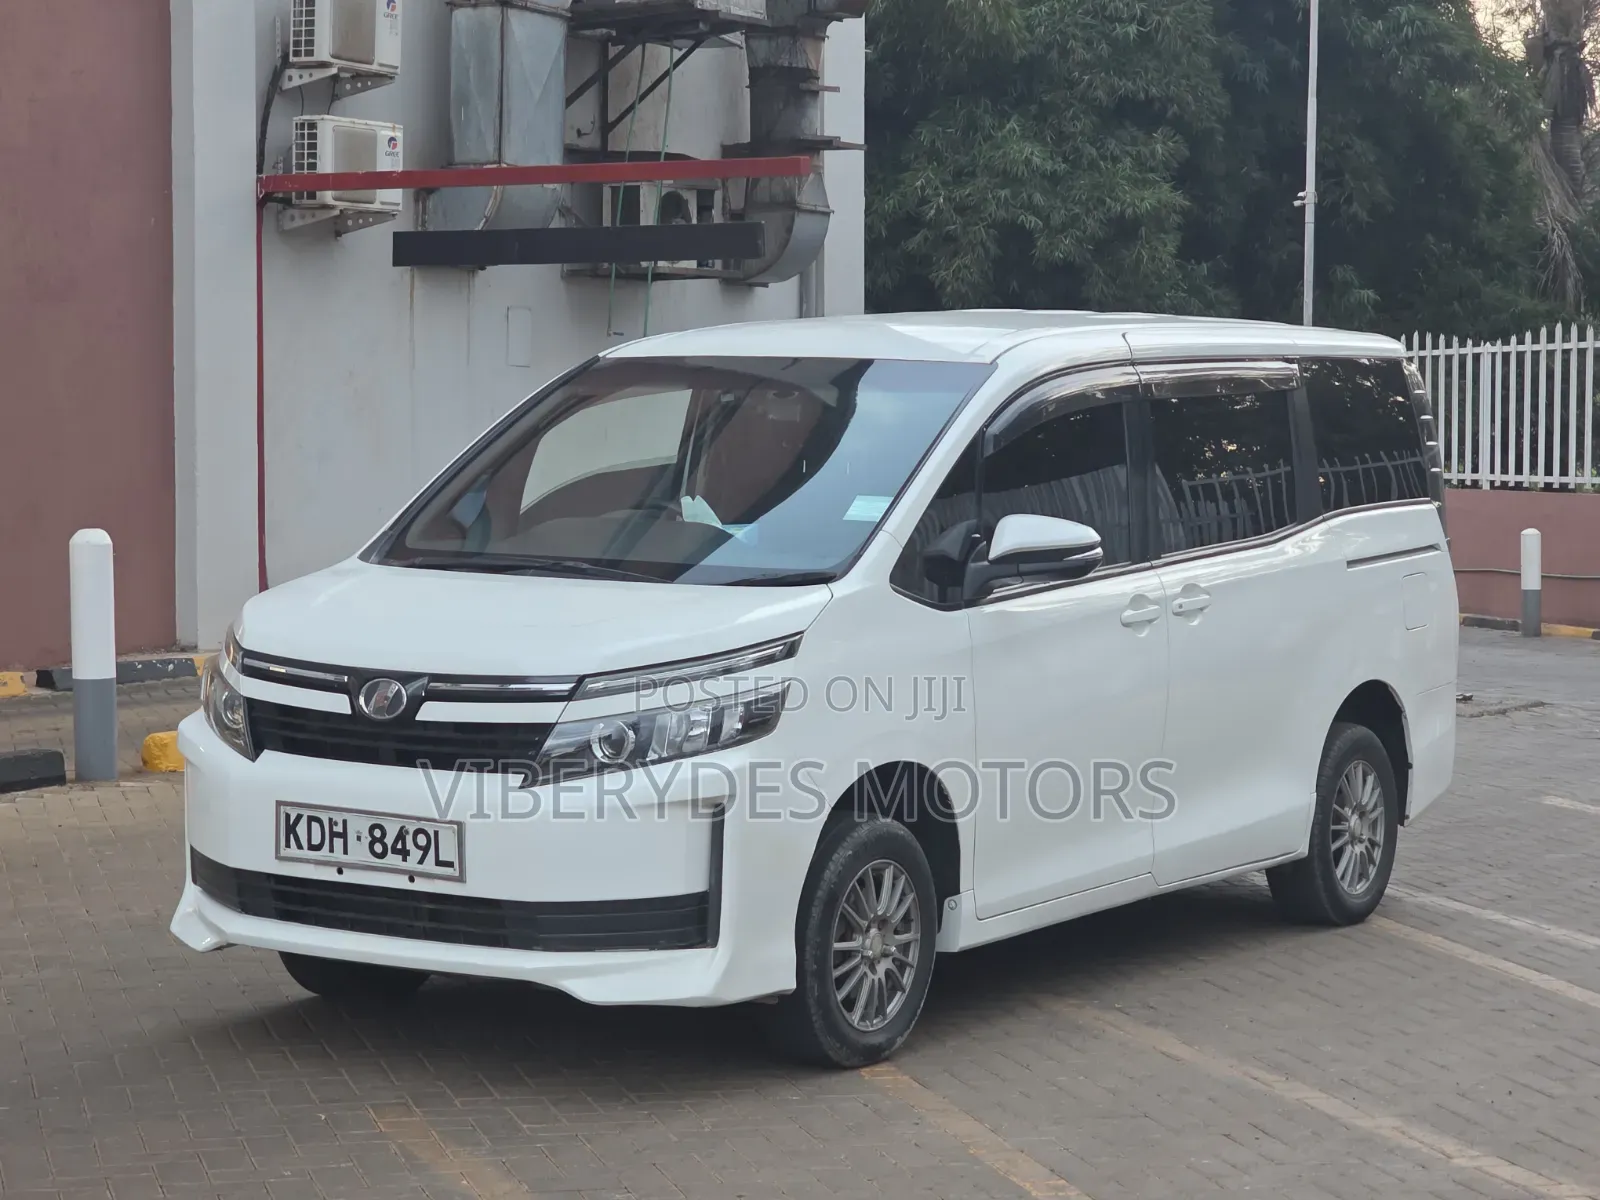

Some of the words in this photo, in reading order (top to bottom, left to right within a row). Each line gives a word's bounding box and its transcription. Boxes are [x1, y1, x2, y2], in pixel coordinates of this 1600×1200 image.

[385, 150, 400, 158] GREE
[284, 802, 349, 856] KDH
[368, 812, 455, 869] 849L
